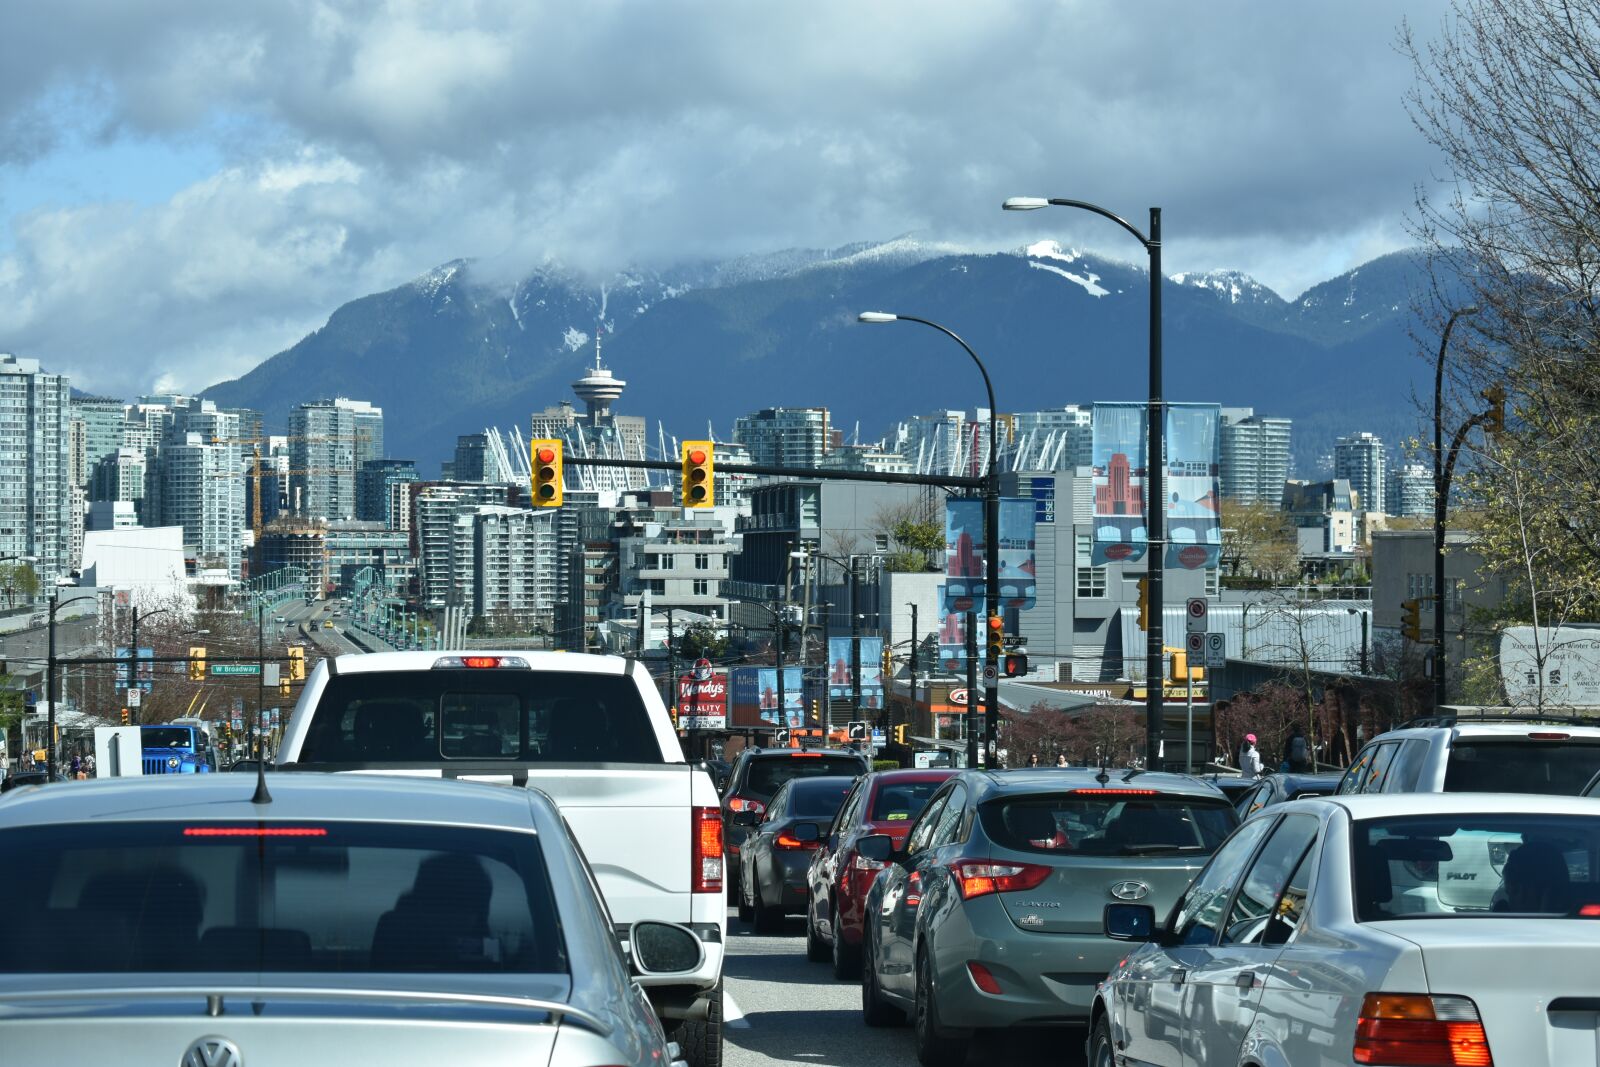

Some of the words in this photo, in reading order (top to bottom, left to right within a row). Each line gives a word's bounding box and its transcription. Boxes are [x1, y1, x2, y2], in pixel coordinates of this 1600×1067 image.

[681, 680, 724, 698] Wendy's
[683, 704, 721, 712] QUALITY
[1446, 872, 1477, 881] PILOT
[1015, 901, 1061, 909] ELANTRA
